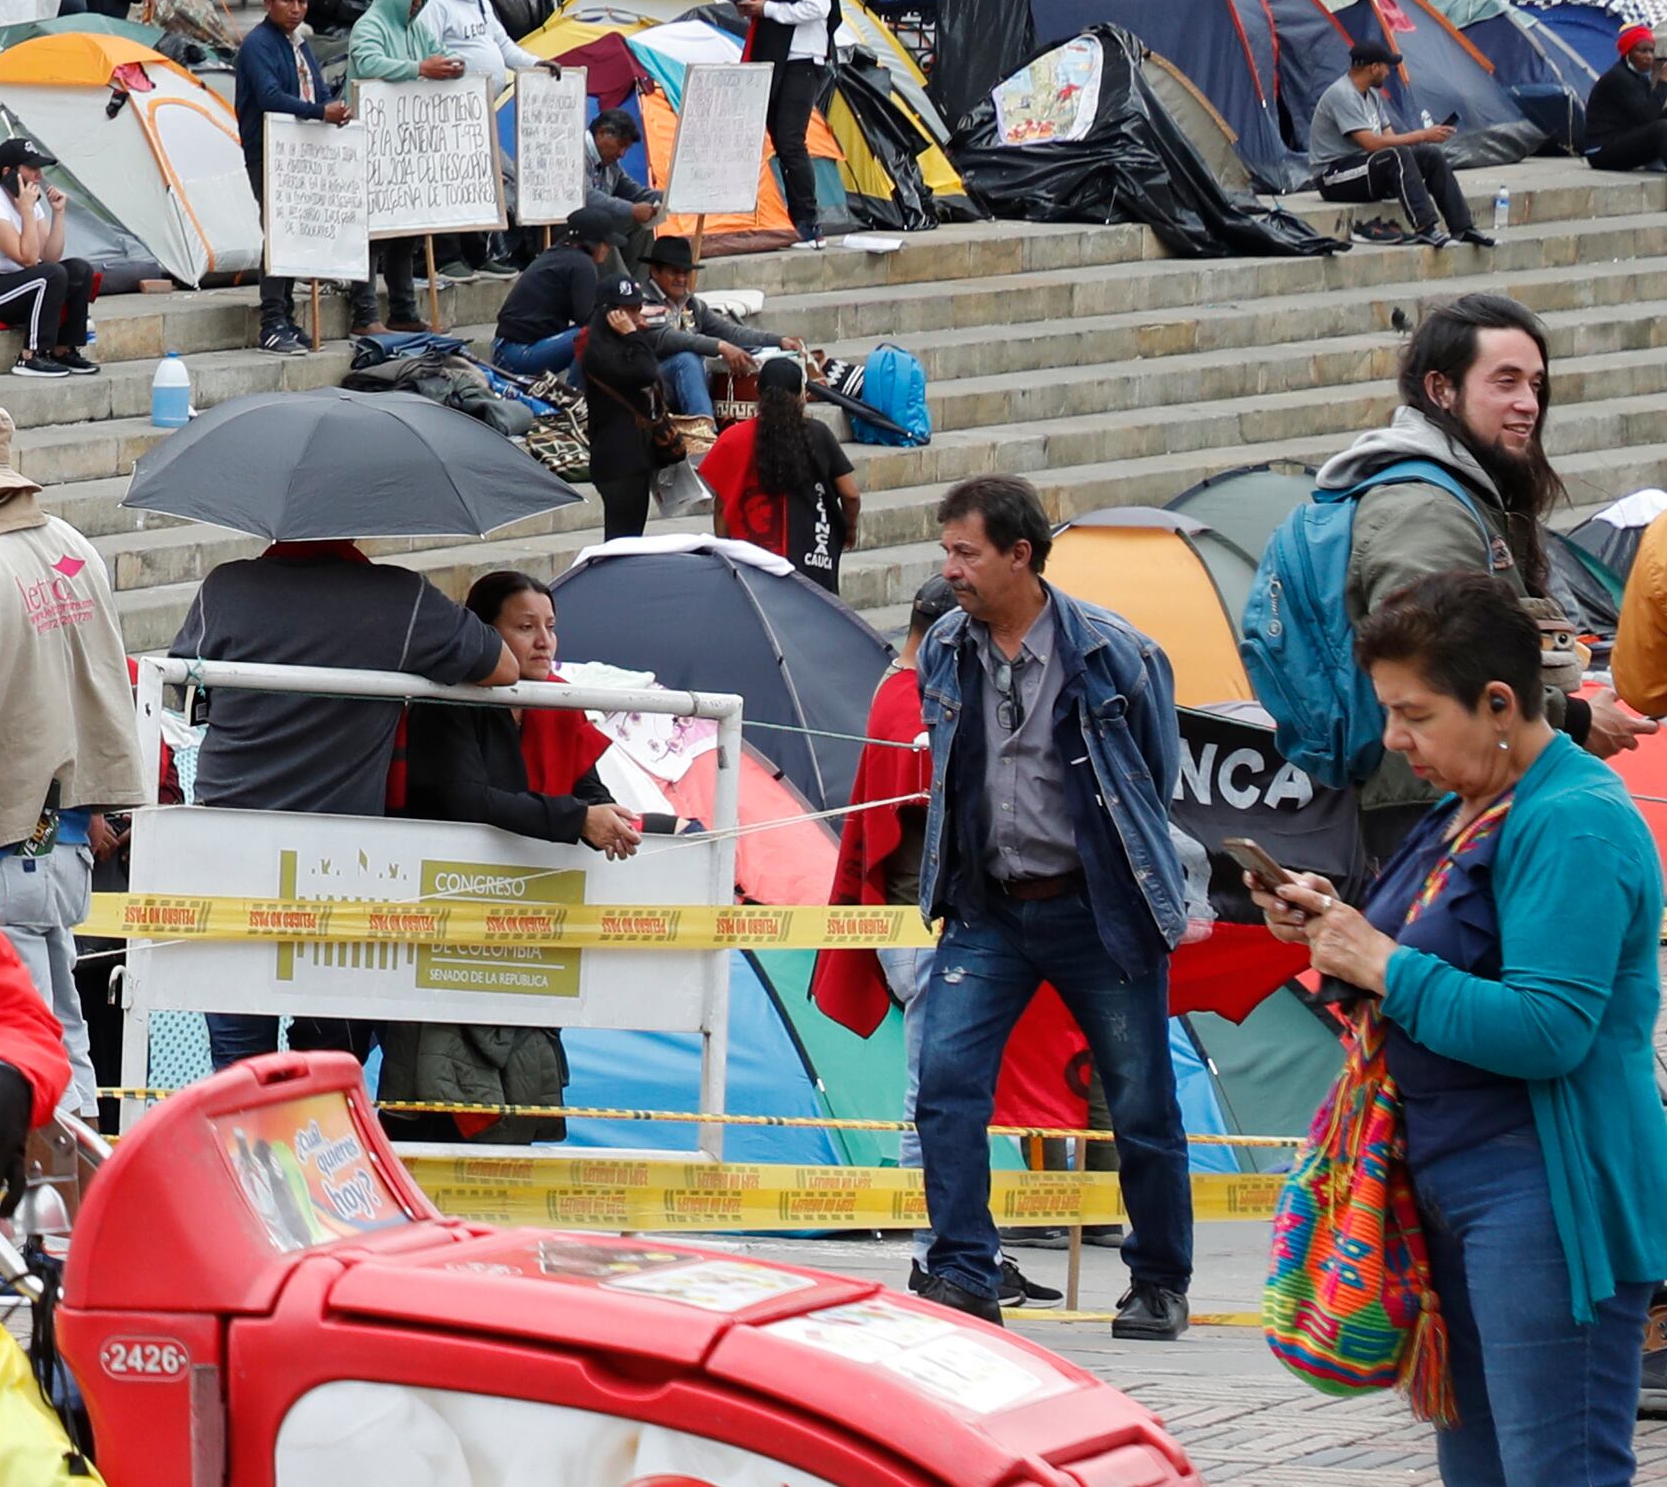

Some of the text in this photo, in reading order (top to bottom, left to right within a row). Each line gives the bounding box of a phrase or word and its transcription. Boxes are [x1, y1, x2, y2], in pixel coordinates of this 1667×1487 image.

[434, 871, 526, 897] CONGRESO
[429, 967, 469, 983] SENADO
[471, 971, 483, 984] DE
[485, 972, 499, 985] LA
[316, 1137, 361, 1178] quieres
[322, 1170, 383, 1221] hoy?
[110, 1342, 180, 1374] 2426
